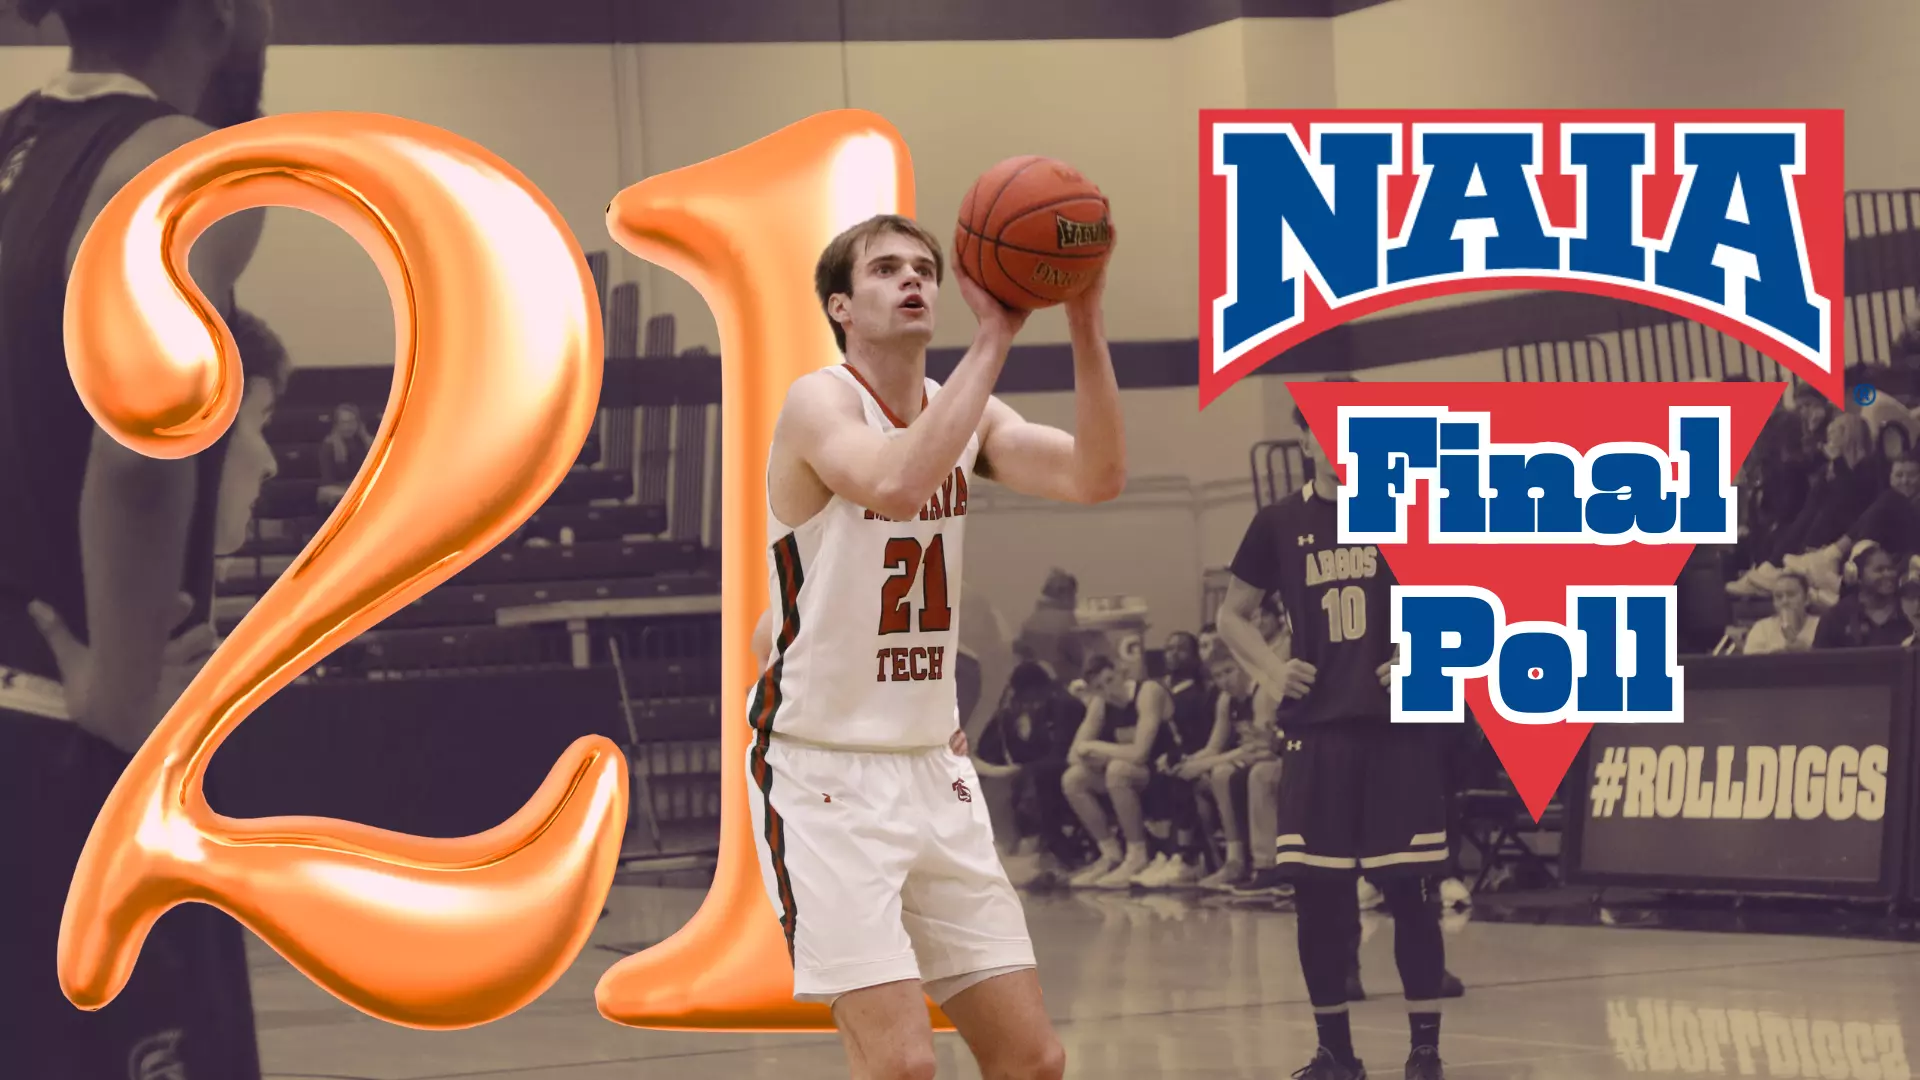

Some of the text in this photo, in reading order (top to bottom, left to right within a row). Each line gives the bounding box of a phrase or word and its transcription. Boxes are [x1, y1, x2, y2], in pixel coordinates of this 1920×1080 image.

[878, 533, 951, 635] 21
[1322, 586, 1366, 642] 10
[876, 646, 945, 681] TECH
[1591, 744, 1888, 821] #ROLLDIGGS
